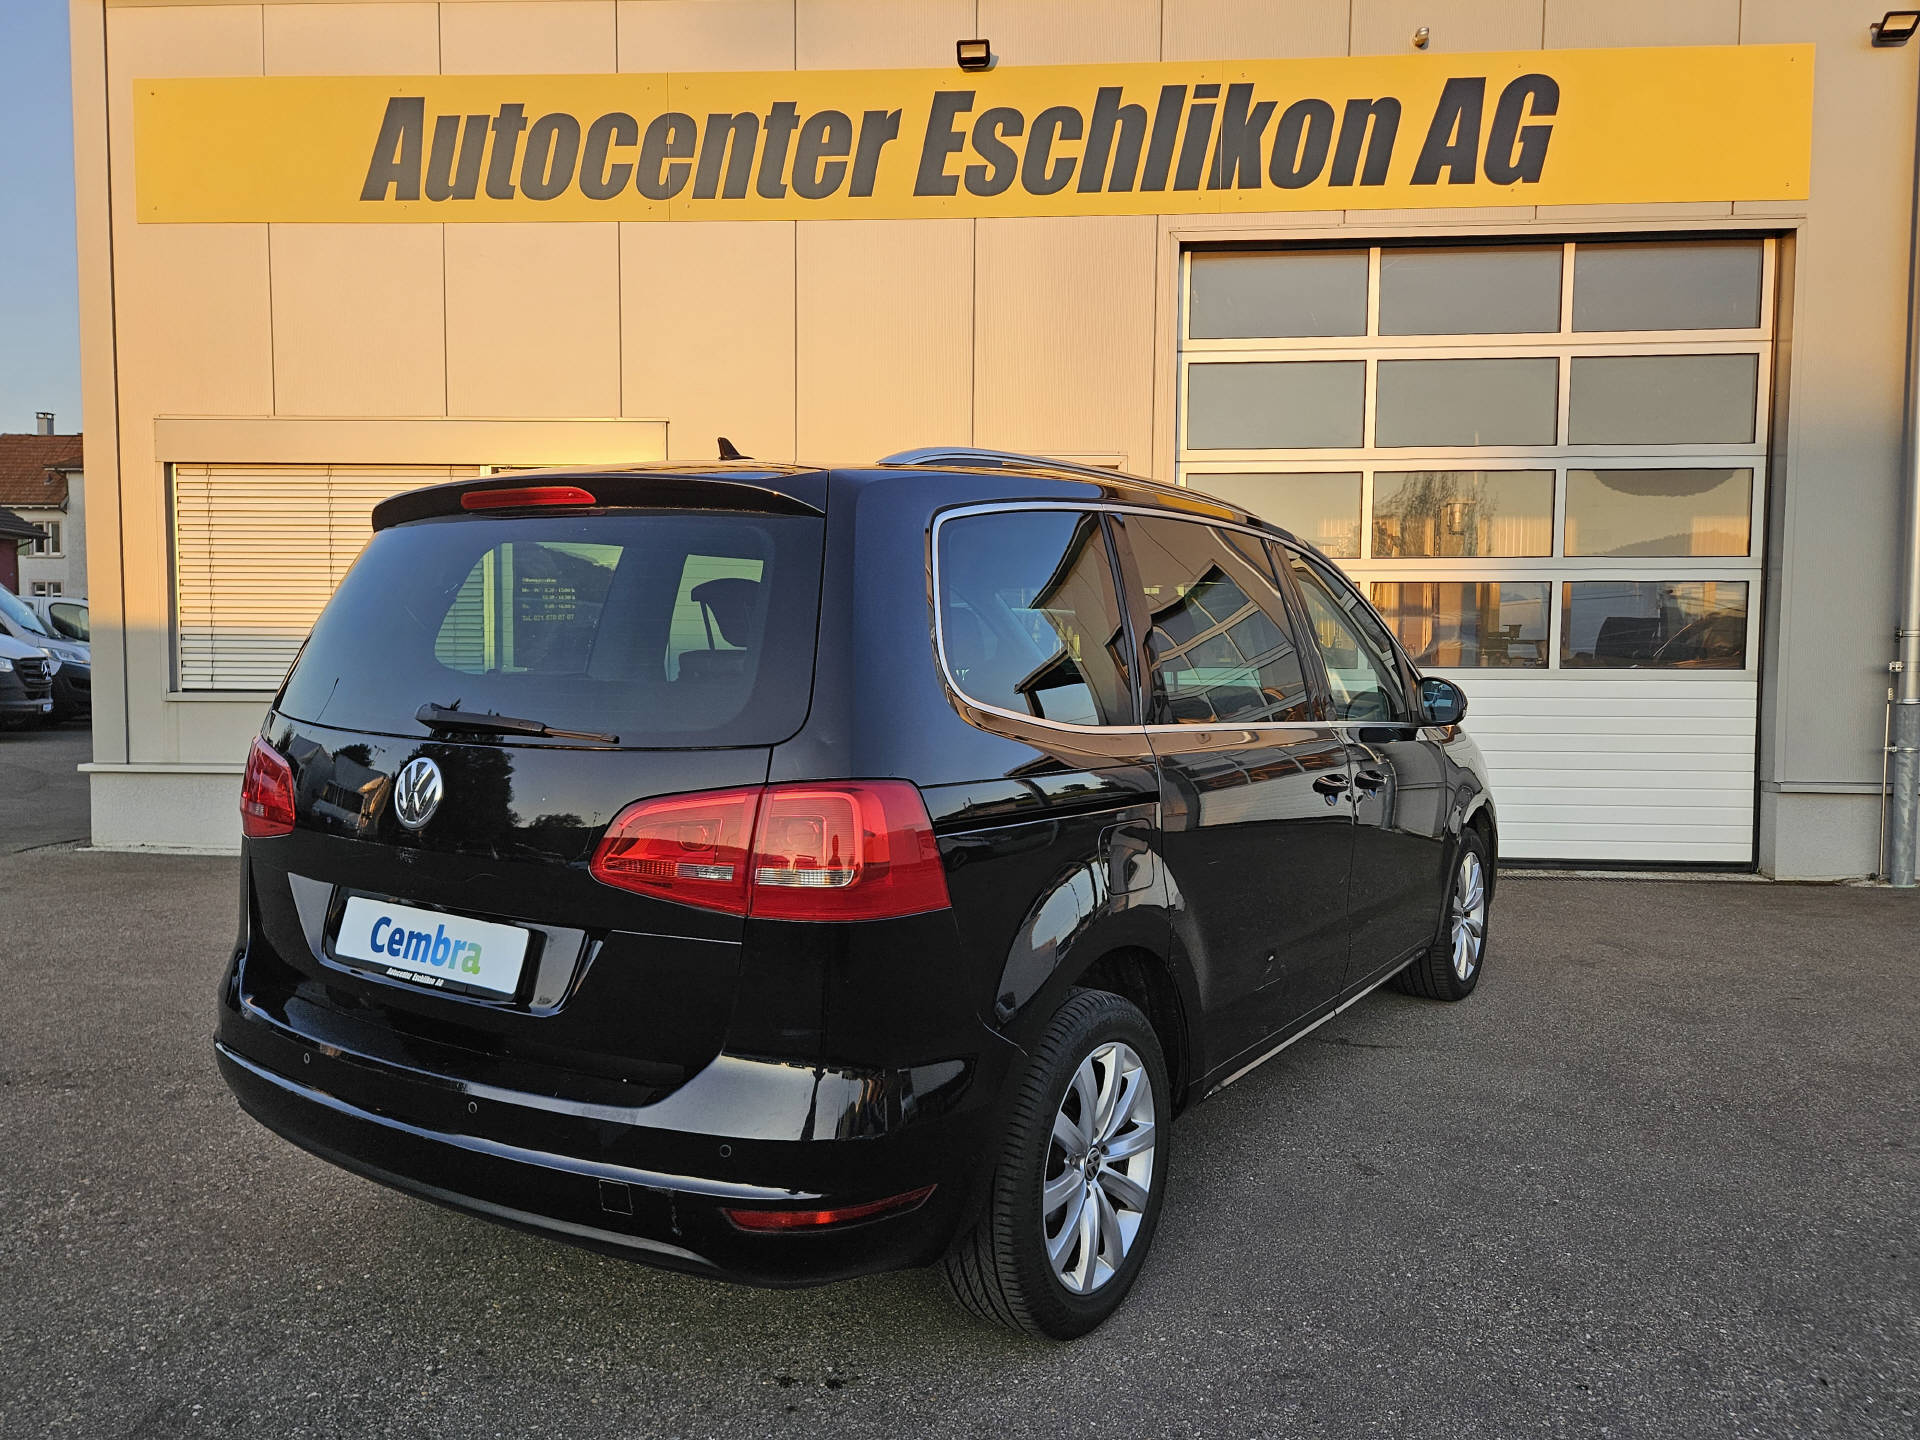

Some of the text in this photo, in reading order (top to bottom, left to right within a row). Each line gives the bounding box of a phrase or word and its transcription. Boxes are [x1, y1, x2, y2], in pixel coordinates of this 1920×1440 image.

[359, 73, 1561, 202] Autocenter Eschlikon AG
[370, 916, 481, 975] Cembra
